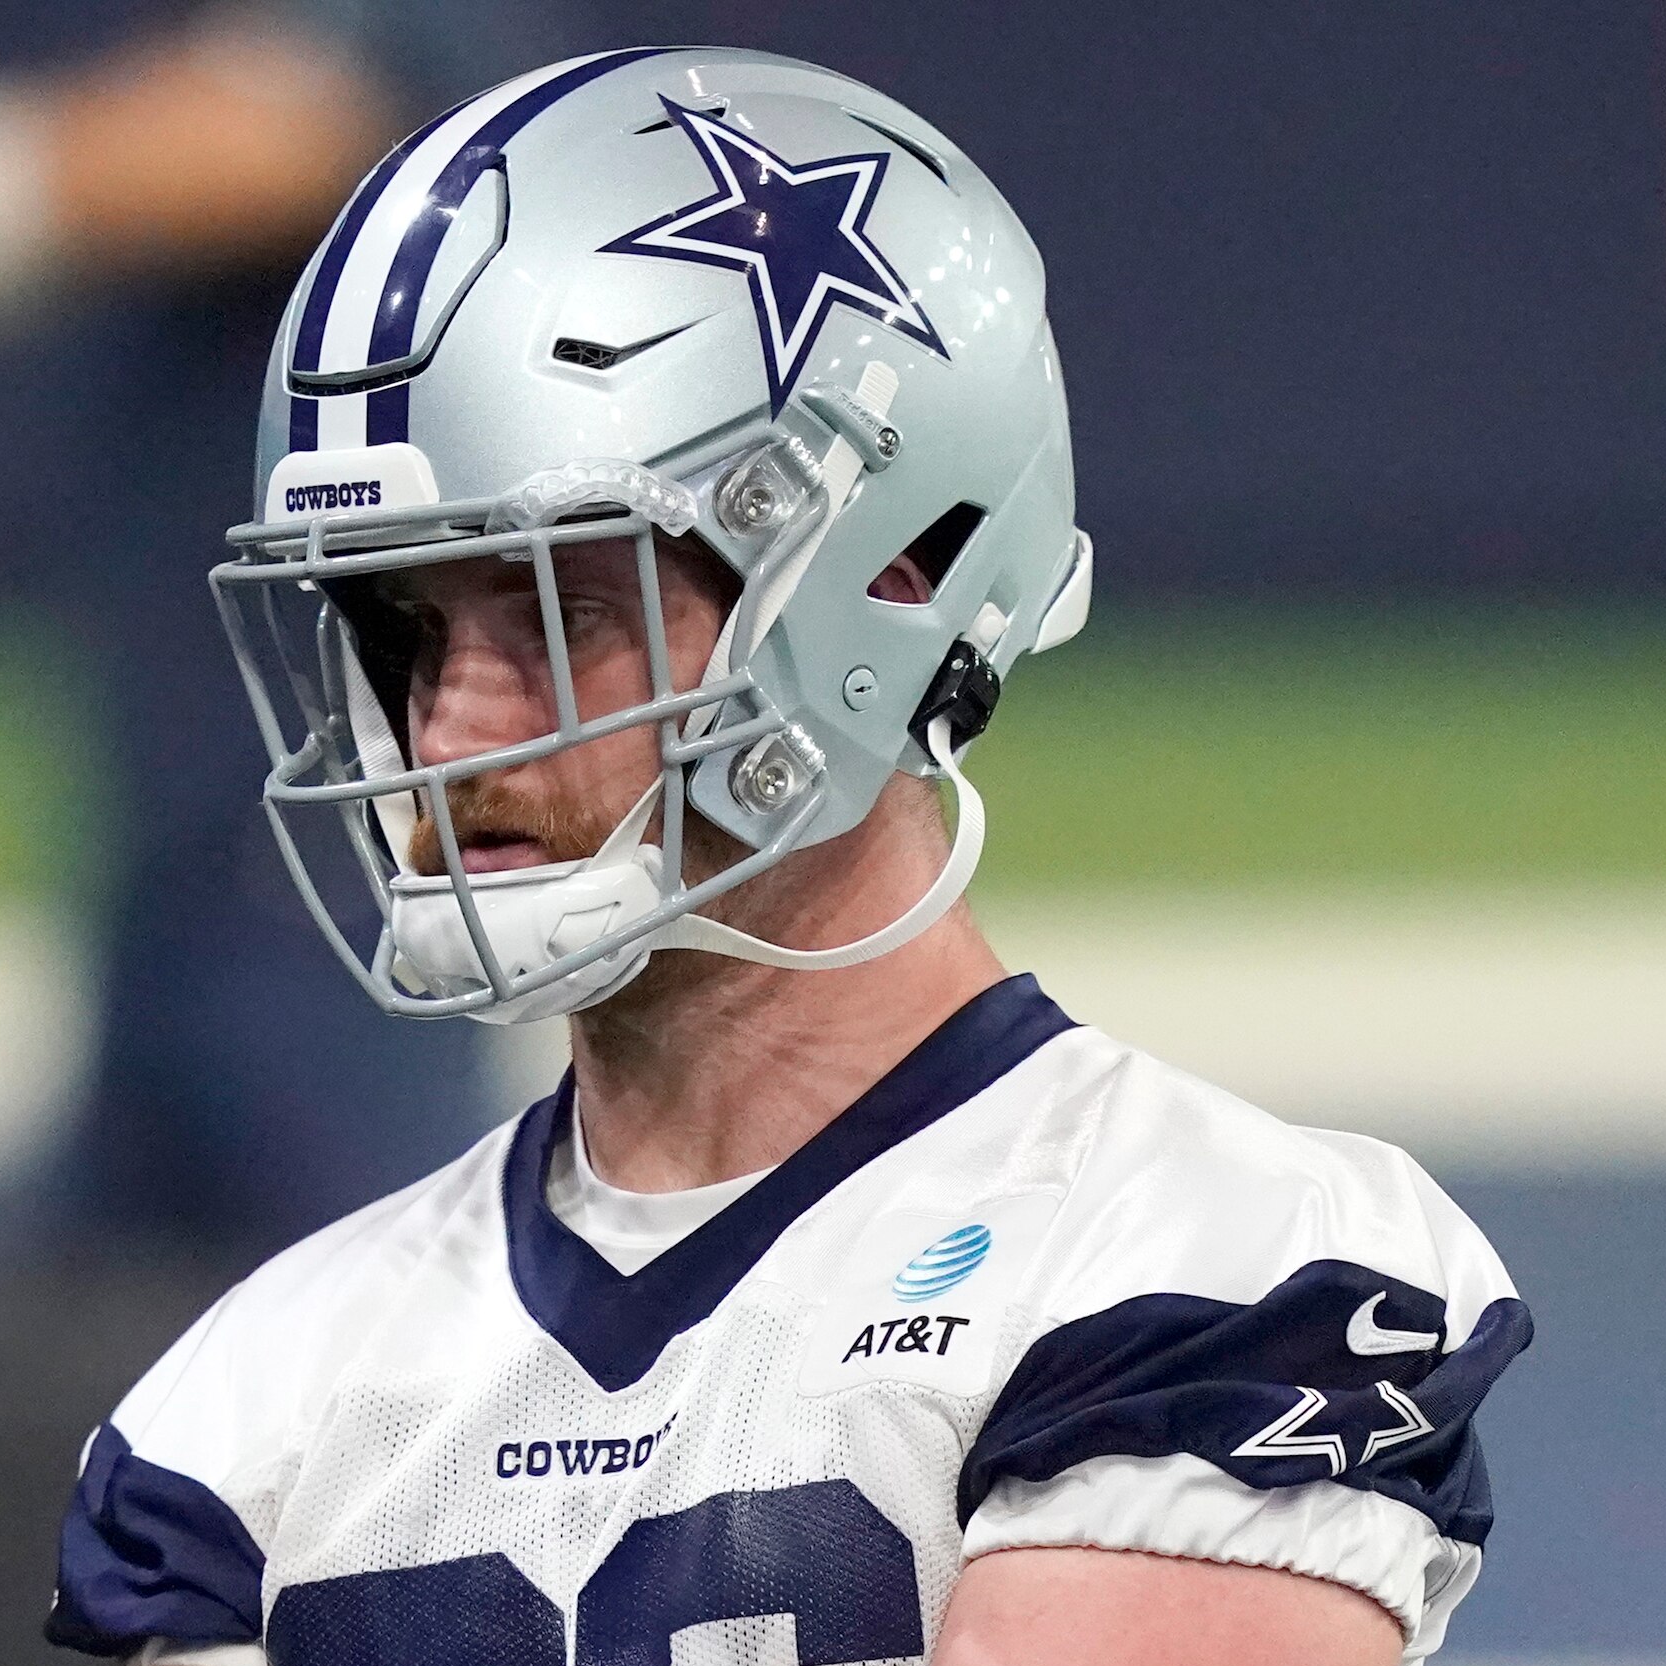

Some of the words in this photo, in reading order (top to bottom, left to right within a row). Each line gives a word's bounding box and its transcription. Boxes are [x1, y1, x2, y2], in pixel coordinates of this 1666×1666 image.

[285, 480, 382, 512] COWBOYS
[841, 1314, 971, 1364] AT&T
[496, 1409, 679, 1479] COWBO
